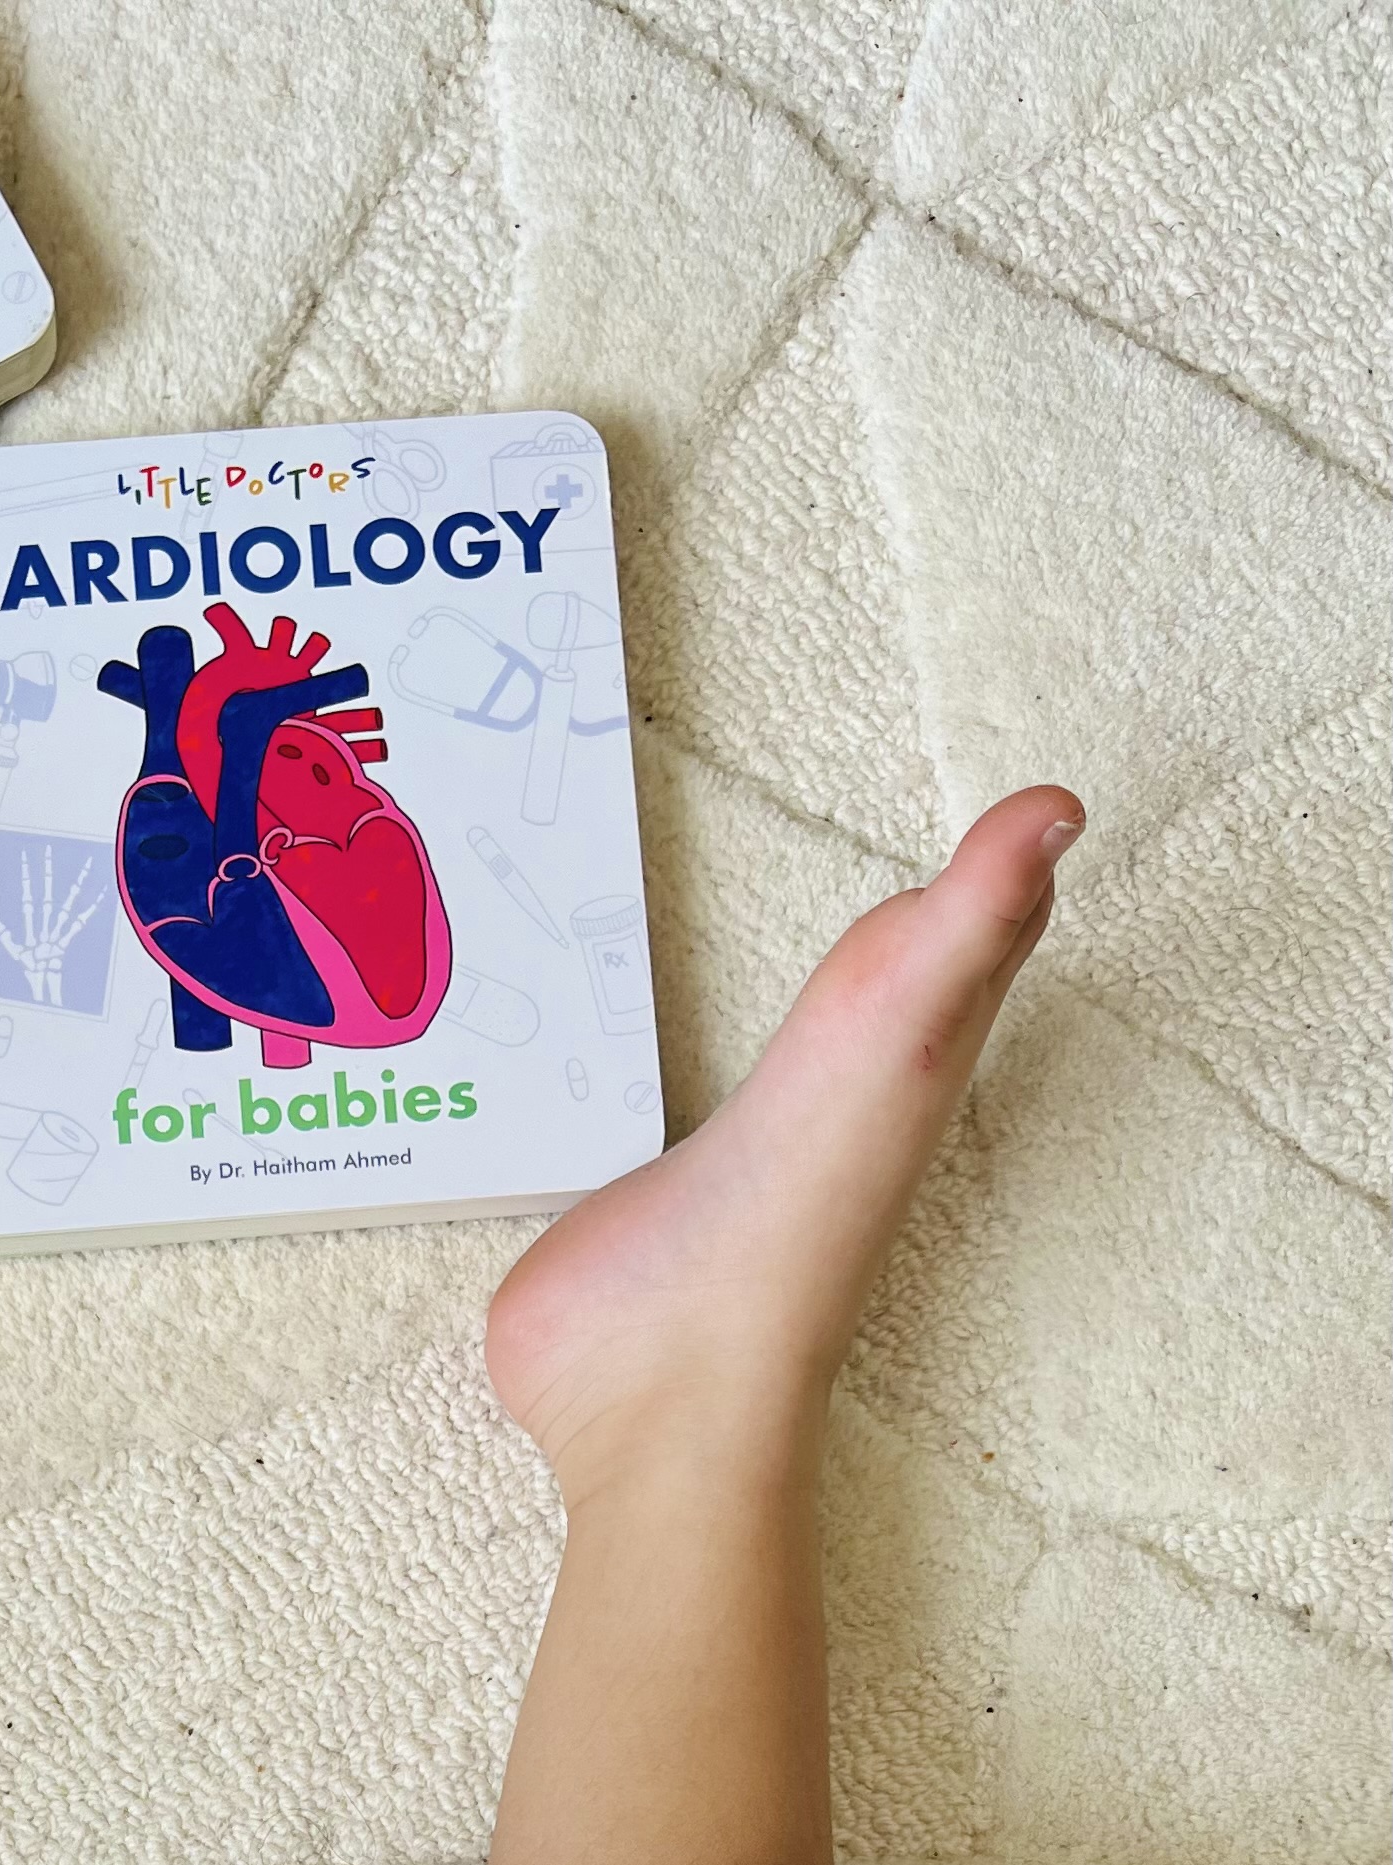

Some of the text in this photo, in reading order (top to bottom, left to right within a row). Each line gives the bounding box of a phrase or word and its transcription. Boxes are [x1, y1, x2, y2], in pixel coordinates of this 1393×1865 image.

[117, 457, 375, 509] LITTLE DOCTORS
[112, 1069, 478, 1145] for babies
[190, 1147, 412, 1185] By Dr. Haitham Ahmed
